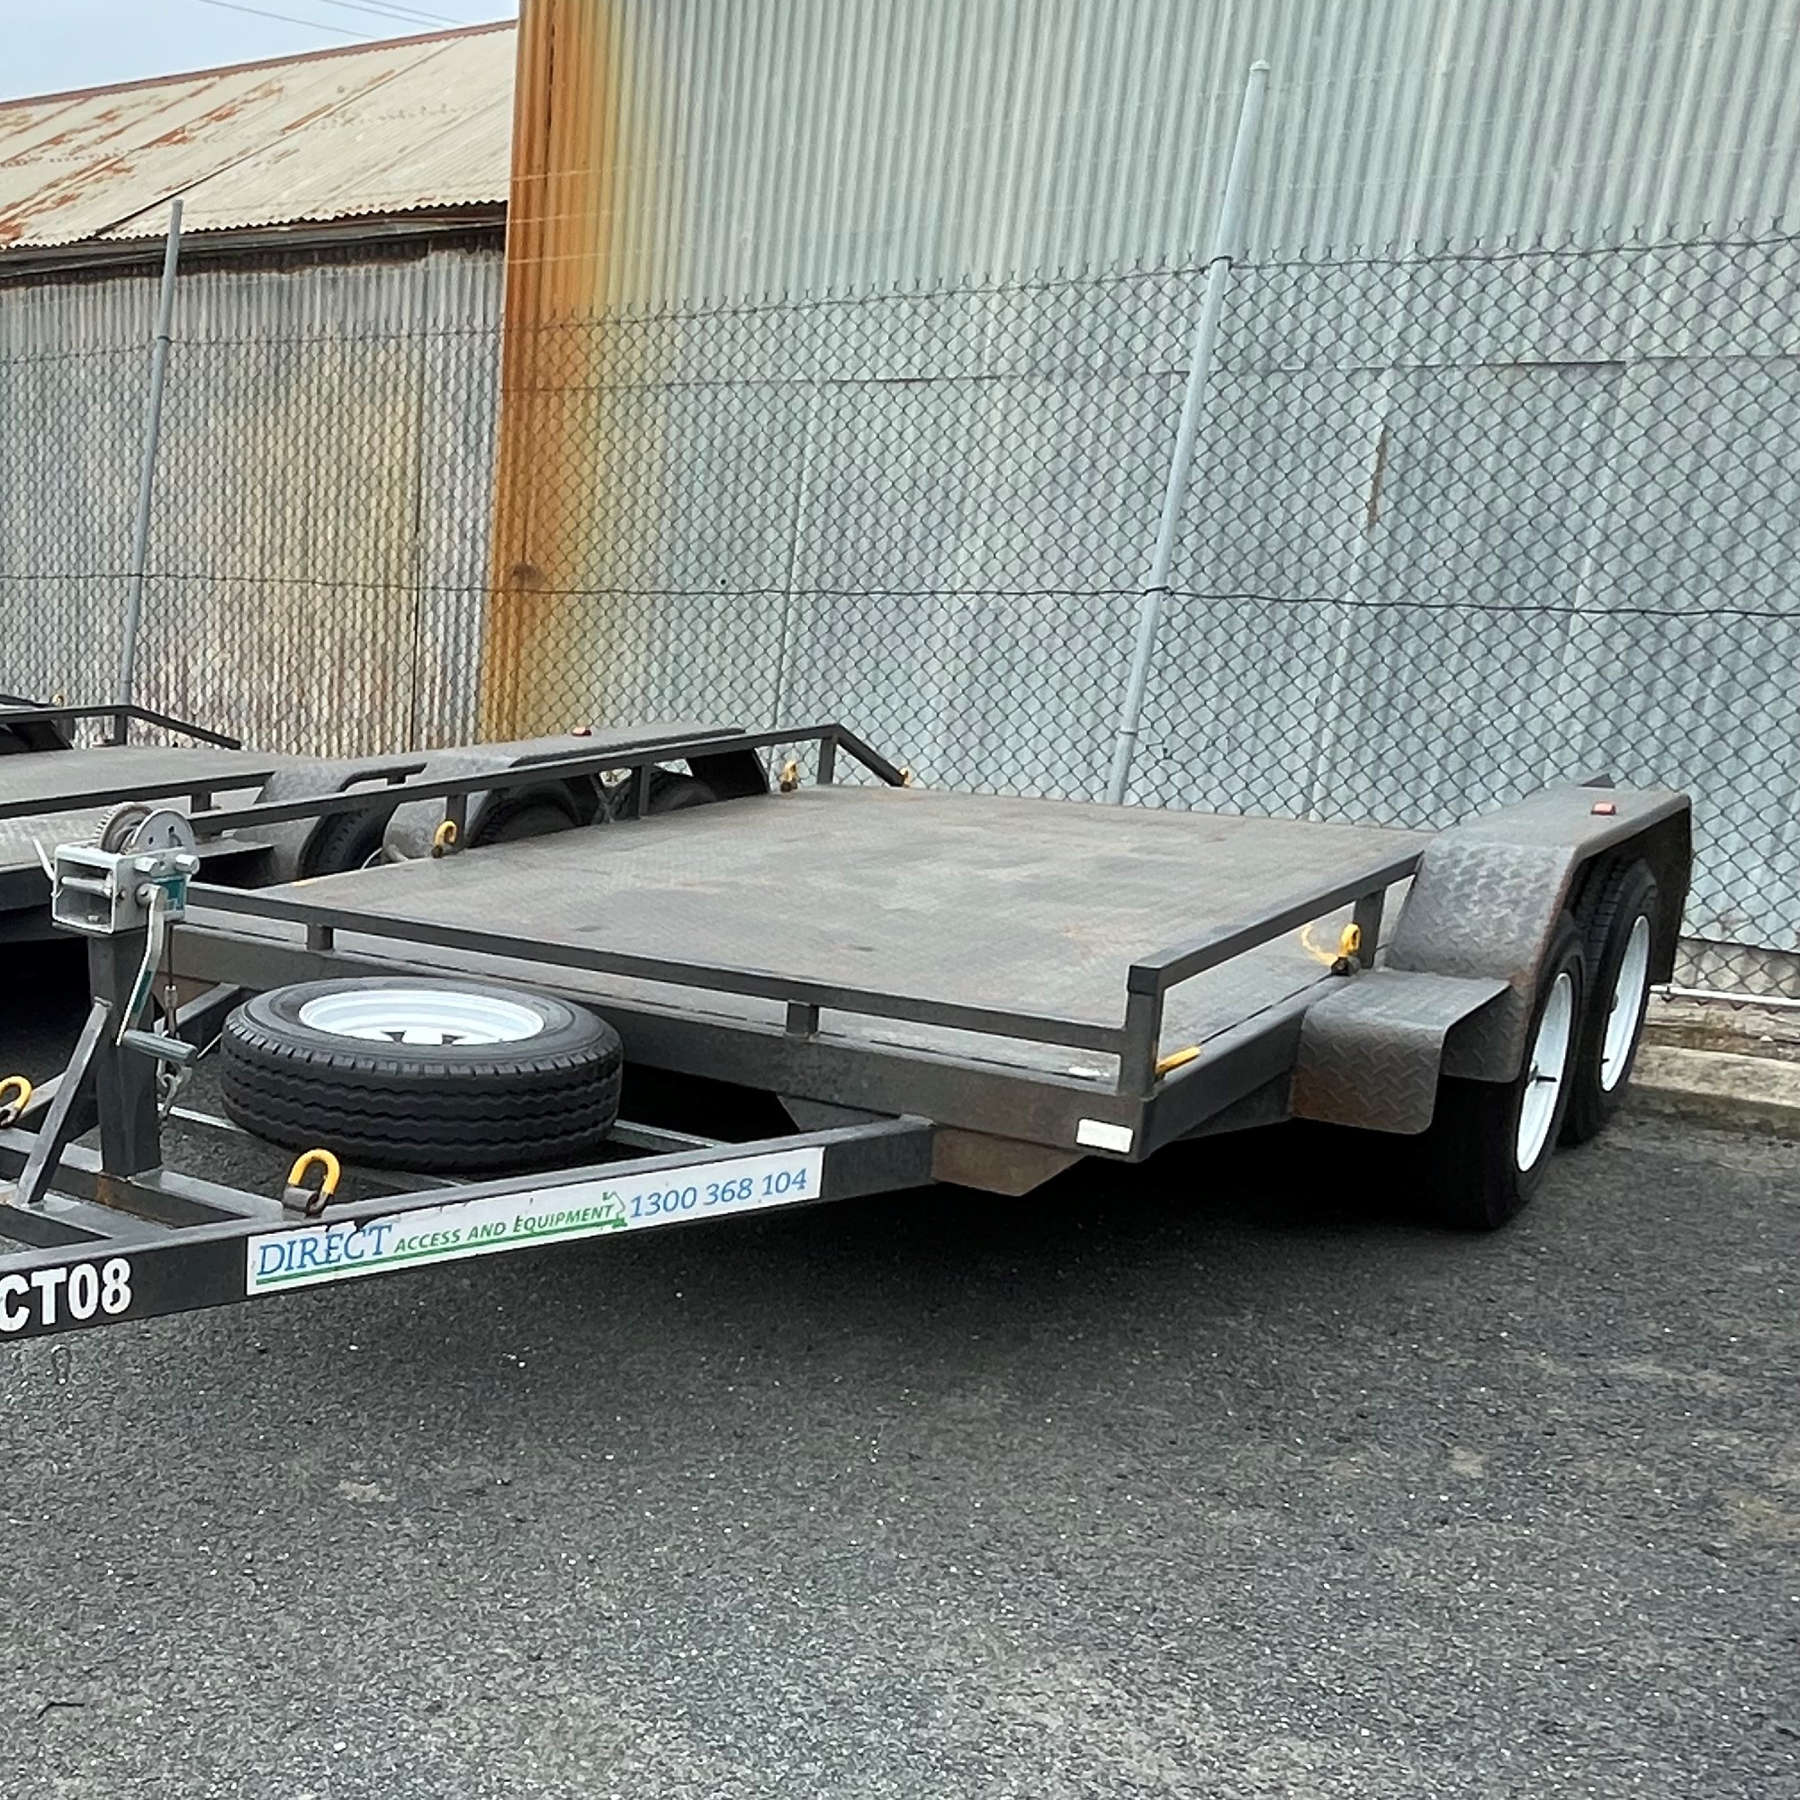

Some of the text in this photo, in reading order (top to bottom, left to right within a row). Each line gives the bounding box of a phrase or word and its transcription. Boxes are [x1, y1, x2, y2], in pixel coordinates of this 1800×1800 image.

[257, 1167, 808, 1277] DIRECT ACCESS AND EQUIPMENT 1300 368 104
